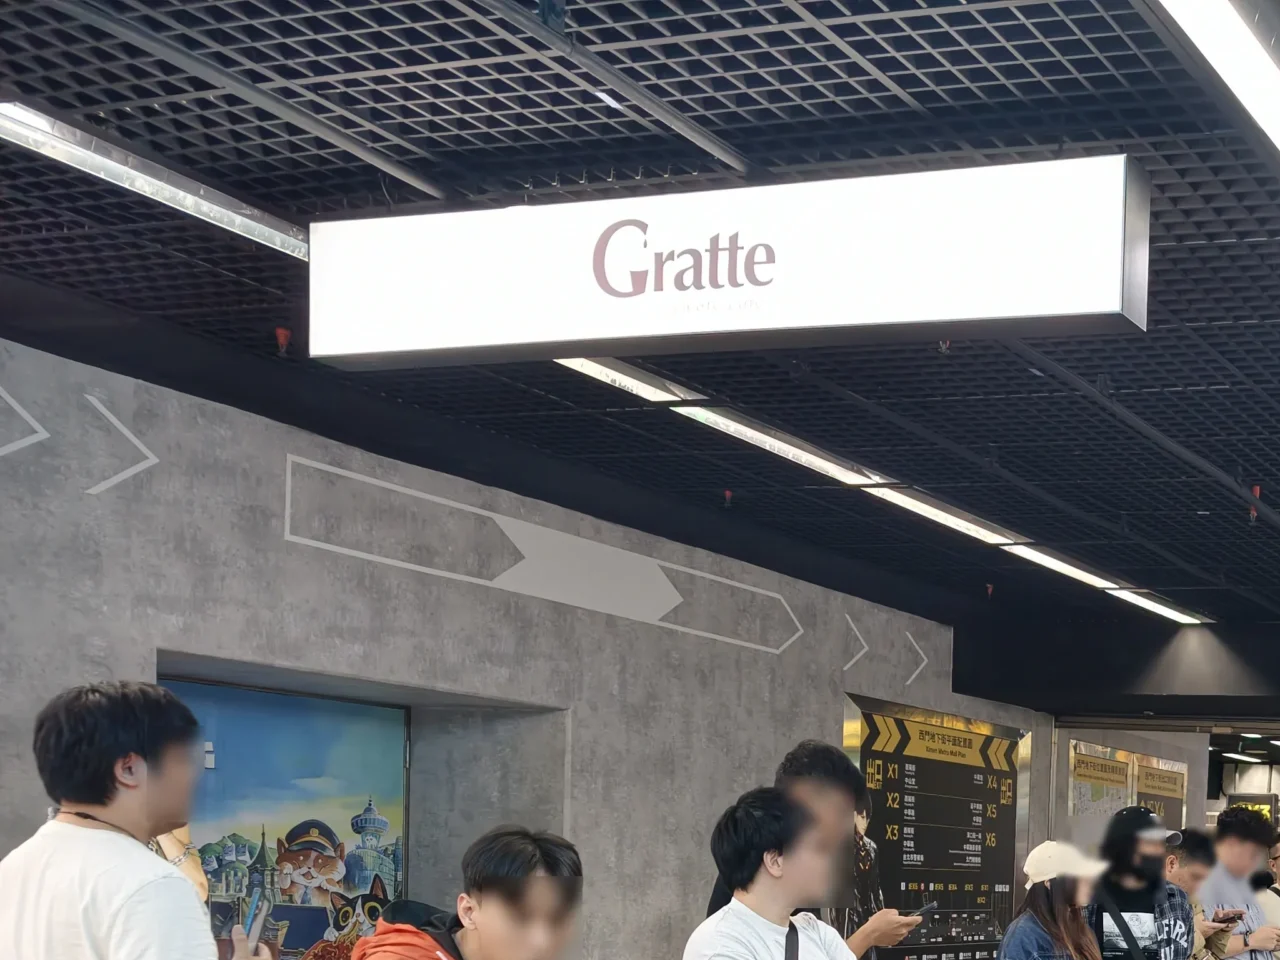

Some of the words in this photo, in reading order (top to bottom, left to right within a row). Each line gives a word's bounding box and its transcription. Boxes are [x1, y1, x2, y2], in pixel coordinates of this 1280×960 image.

[593, 218, 776, 299] Gratte
[887, 763, 899, 779] X1
[987, 774, 998, 790] X4
[886, 792, 900, 808] X2
[986, 803, 997, 818] X5
[886, 824, 899, 840] X3
[985, 832, 996, 847] X6
